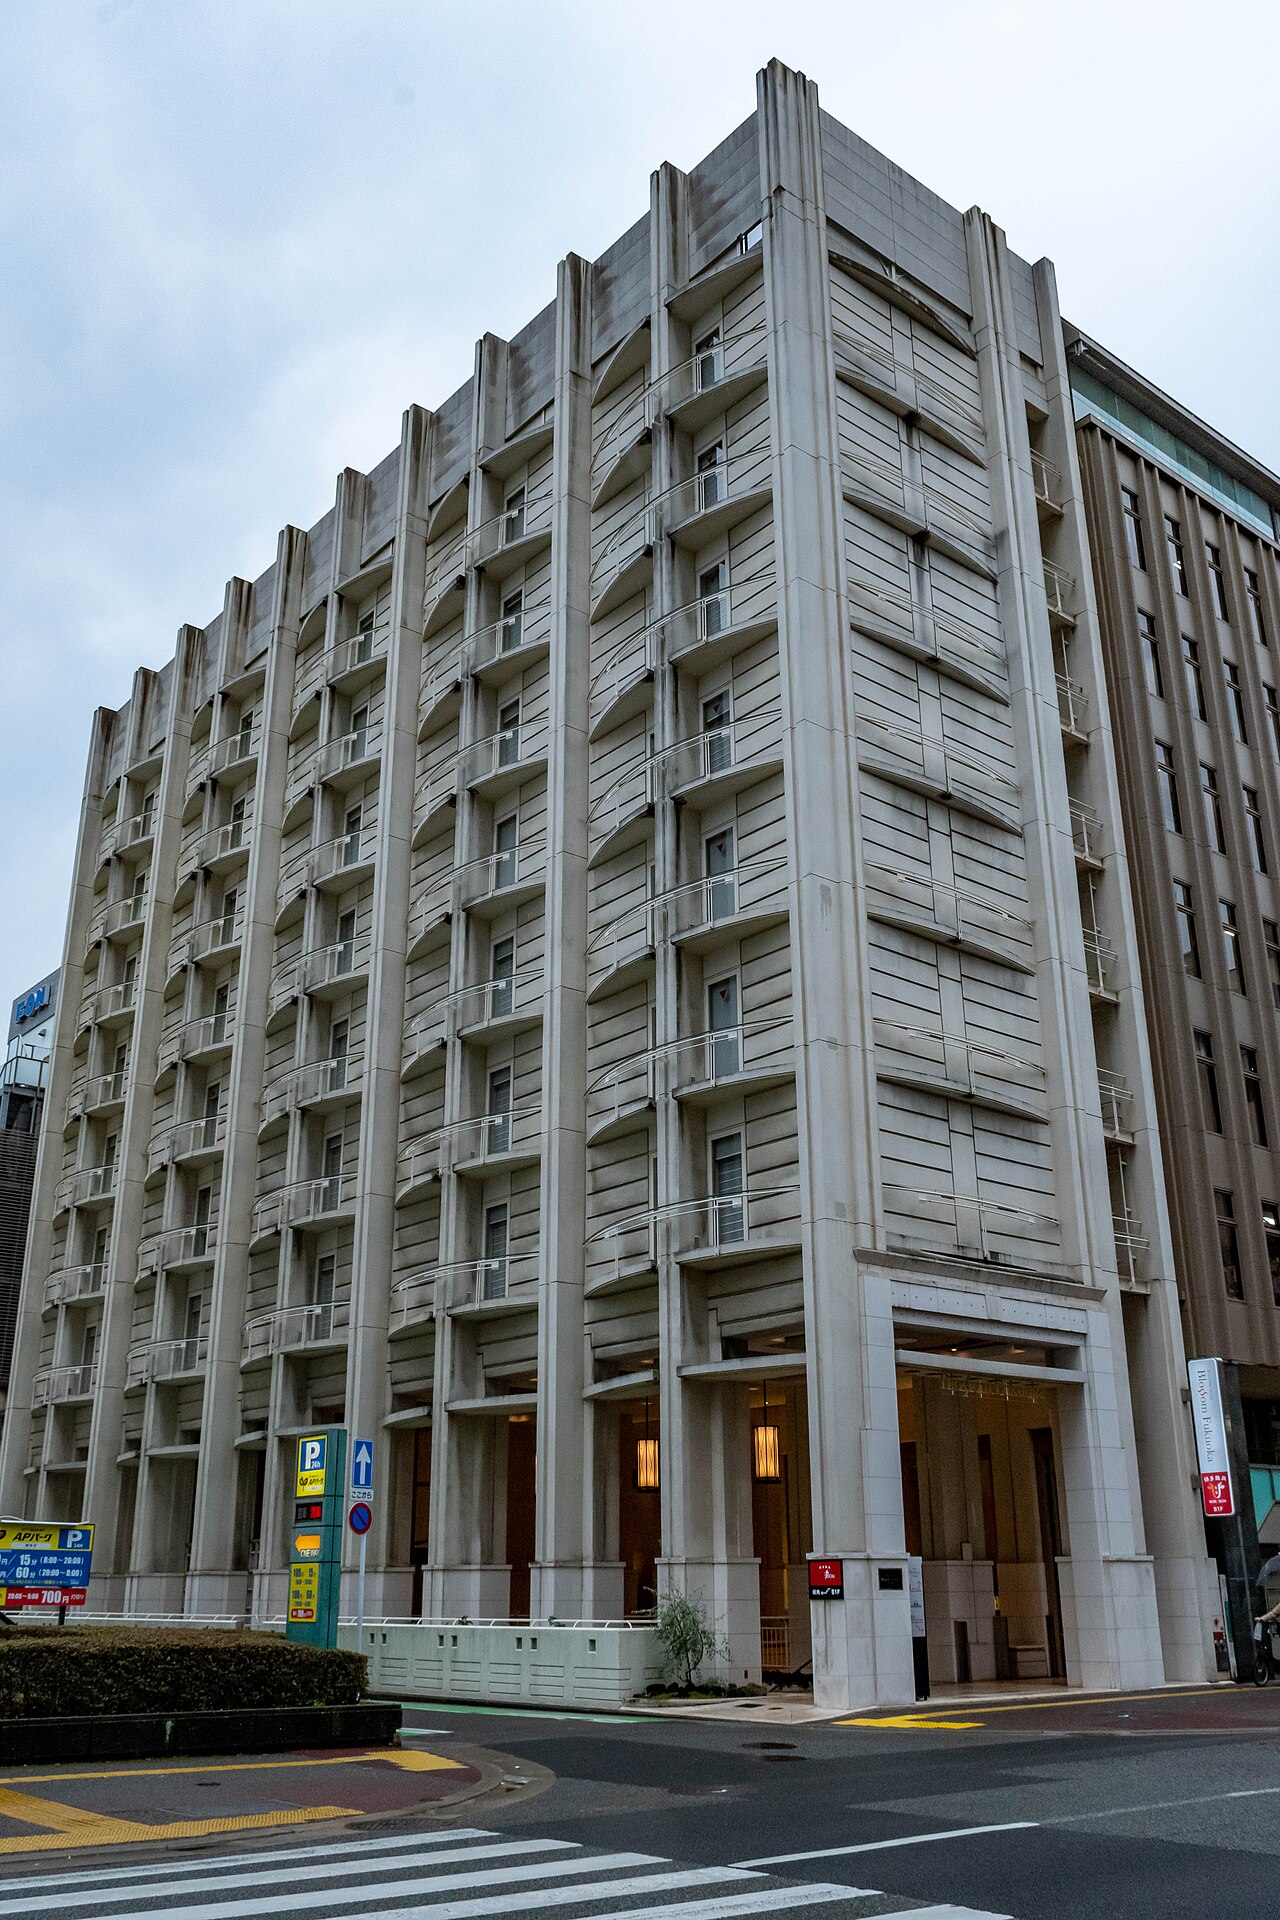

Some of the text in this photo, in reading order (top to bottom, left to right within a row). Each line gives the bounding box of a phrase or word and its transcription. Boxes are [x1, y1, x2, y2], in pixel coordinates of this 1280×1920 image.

[1203, 1417, 1214, 1462] Fukuoka
[305, 1441, 320, 1470] P
[351, 1490, 372, 1499] ここから
[13, 1533, 52, 1541] APパーク
[66, 1530, 83, 1548] P
